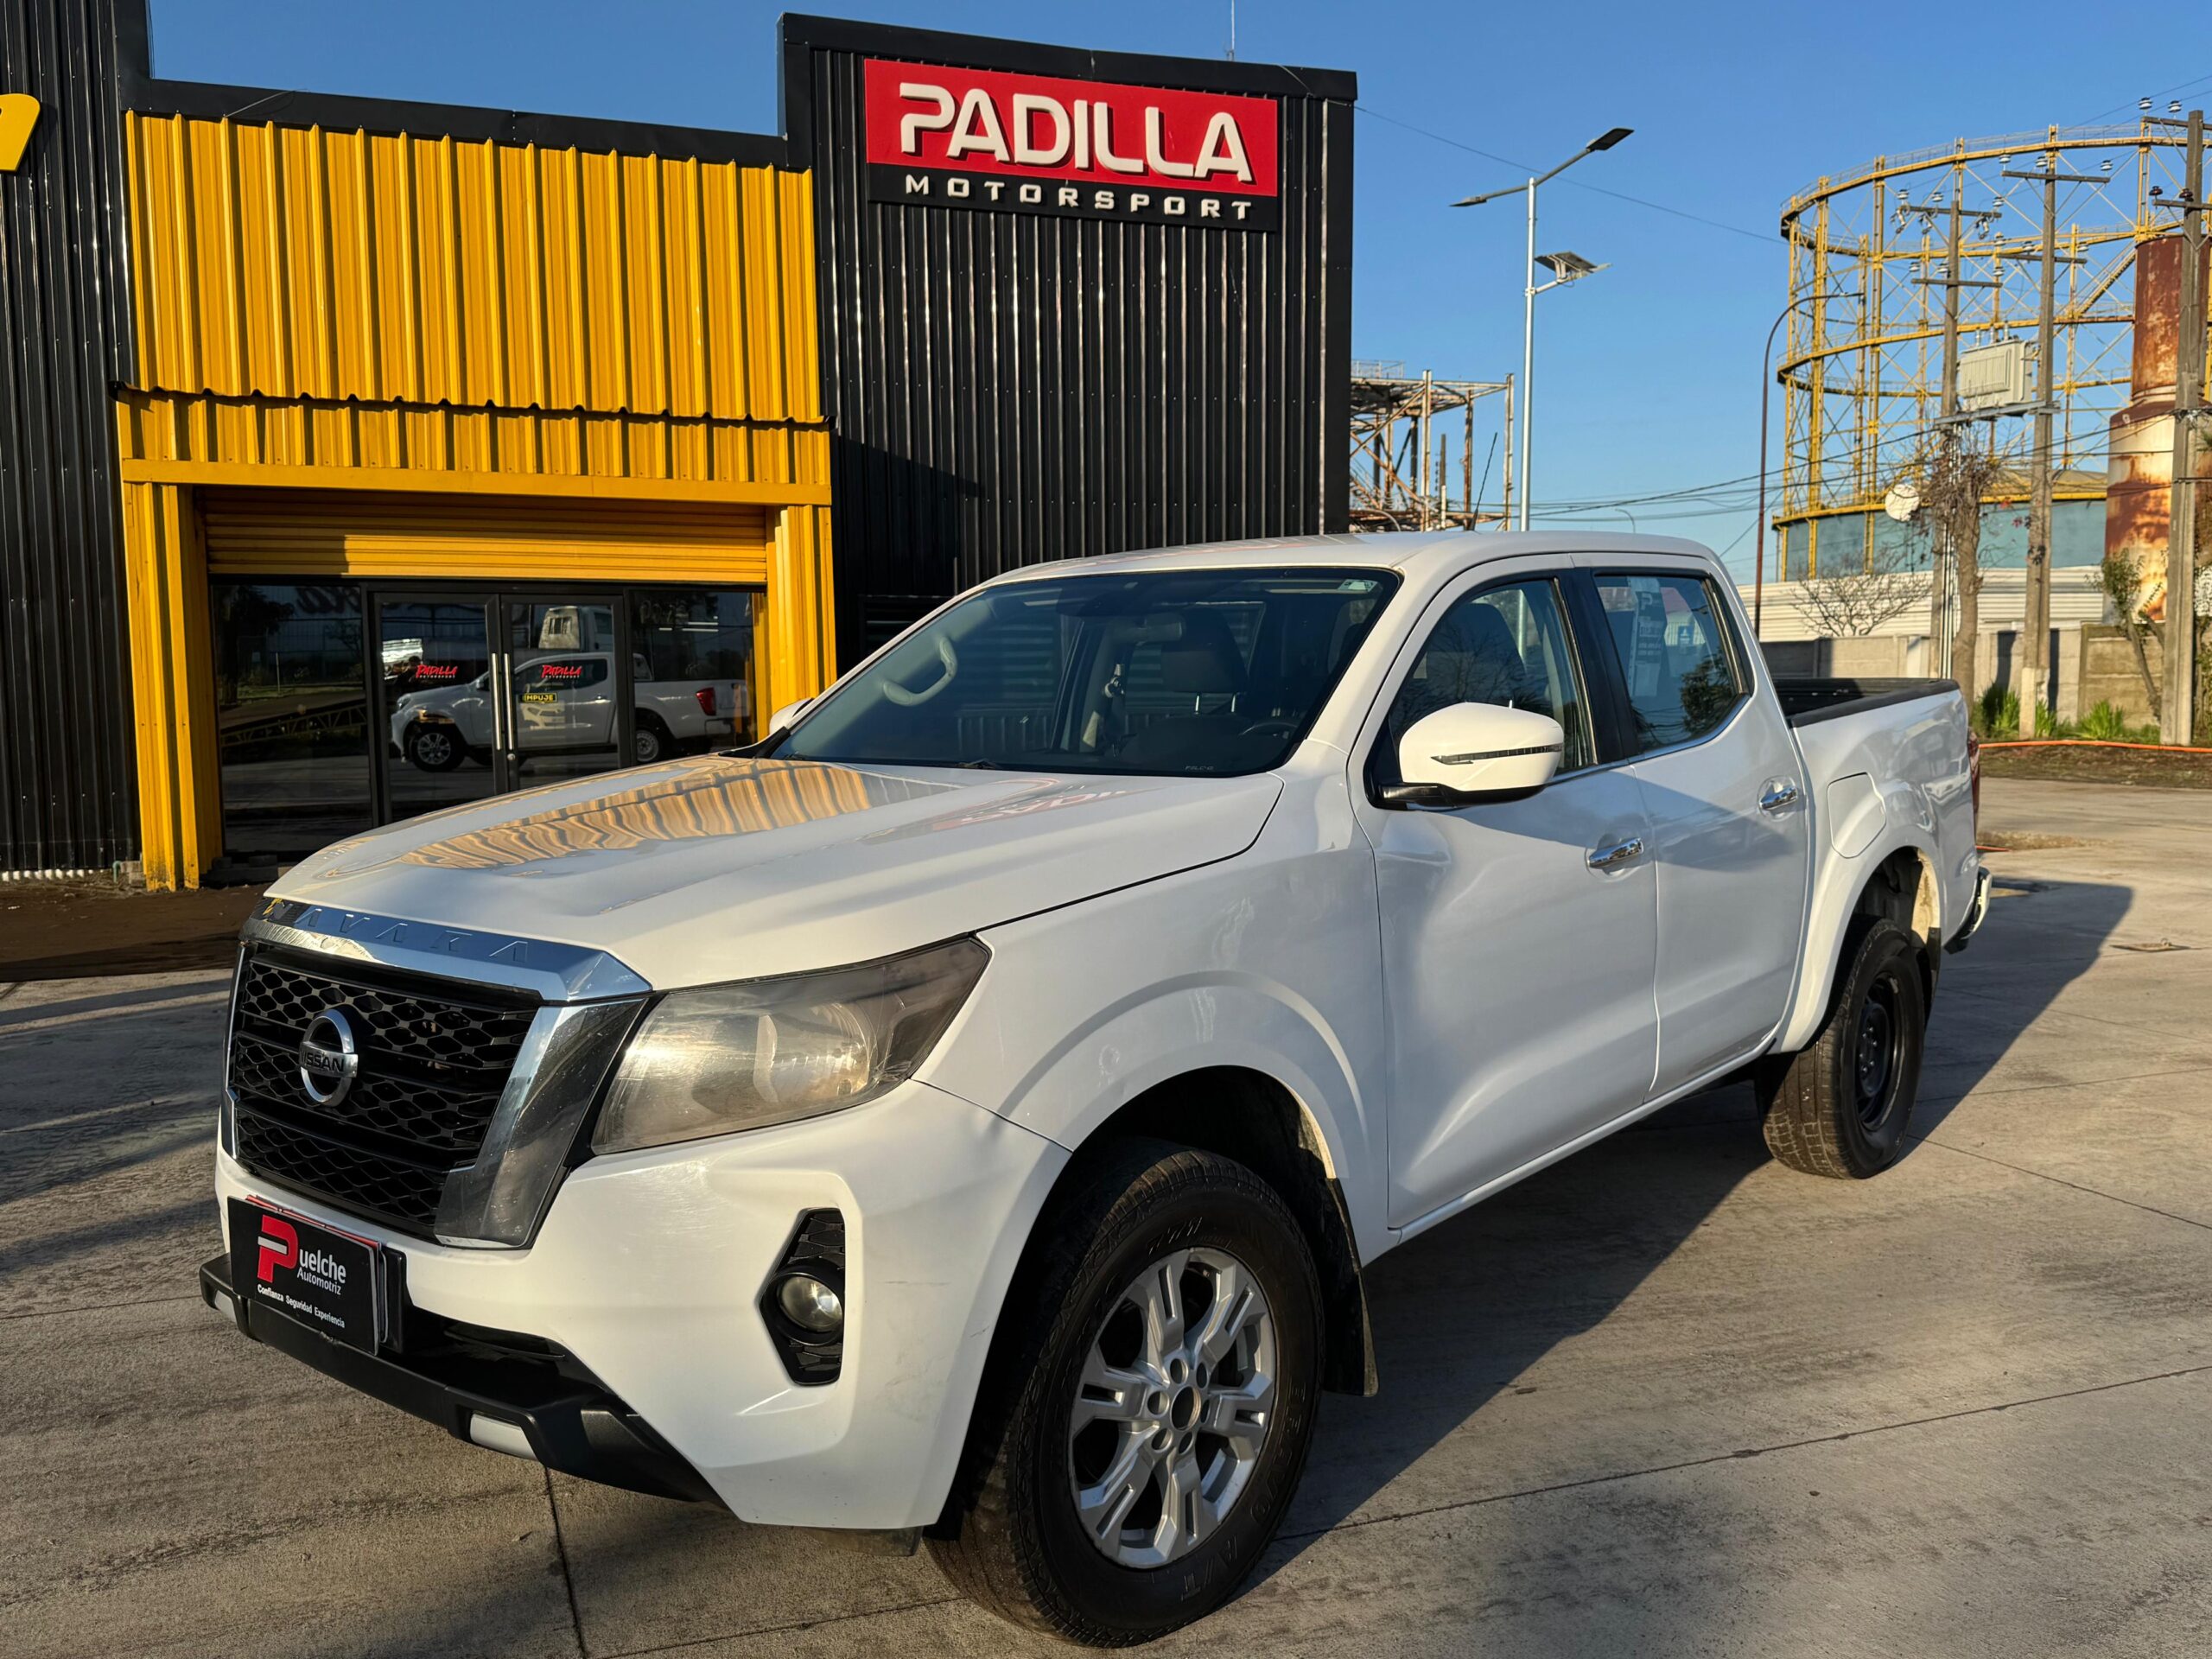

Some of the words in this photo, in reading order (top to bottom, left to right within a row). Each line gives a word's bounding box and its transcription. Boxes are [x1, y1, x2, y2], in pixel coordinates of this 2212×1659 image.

[899, 82, 1252, 183] PADILLA
[905, 175, 1252, 220] MOTORSPORT
[416, 664, 458, 678] PADILLA
[541, 664, 582, 678] PADILLA
[299, 1049, 345, 1072] NISSAN
[257, 1215, 346, 1284] Puelche
[296, 1267, 341, 1295] Automotriz
[257, 1284, 284, 1302] Confianza
[285, 1295, 313, 1313] Seguridad
[314, 1306, 346, 1329] Experiencia
